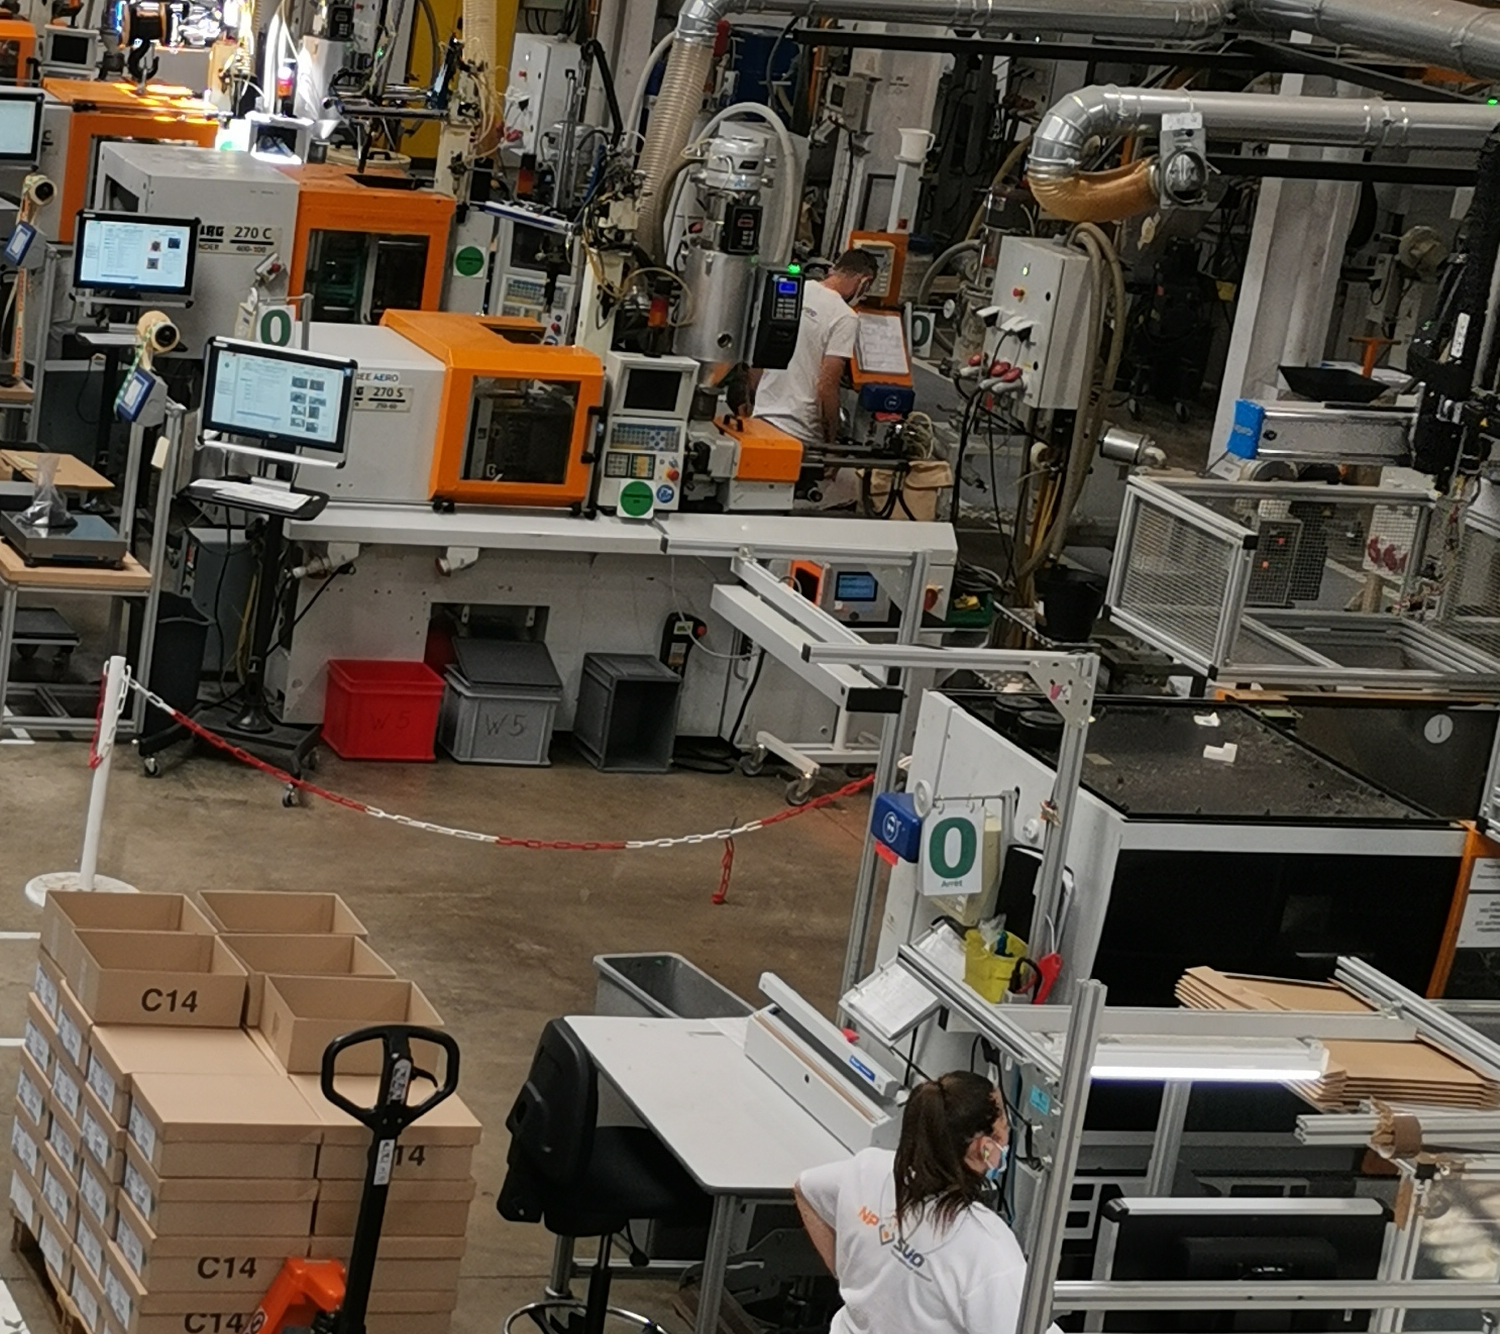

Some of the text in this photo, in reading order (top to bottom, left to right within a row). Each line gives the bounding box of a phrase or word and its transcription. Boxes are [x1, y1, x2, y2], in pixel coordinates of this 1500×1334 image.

[235, 227, 259, 239] 270
[263, 228, 272, 239] C
[260, 309, 292, 347] 0
[373, 387, 394, 397] 270
[929, 817, 977, 879] 0
[142, 988, 198, 1012] C14
[395, 1145, 425, 1166] 14
[197, 1256, 257, 1279] C14
[184, 1313, 243, 1334] C14
